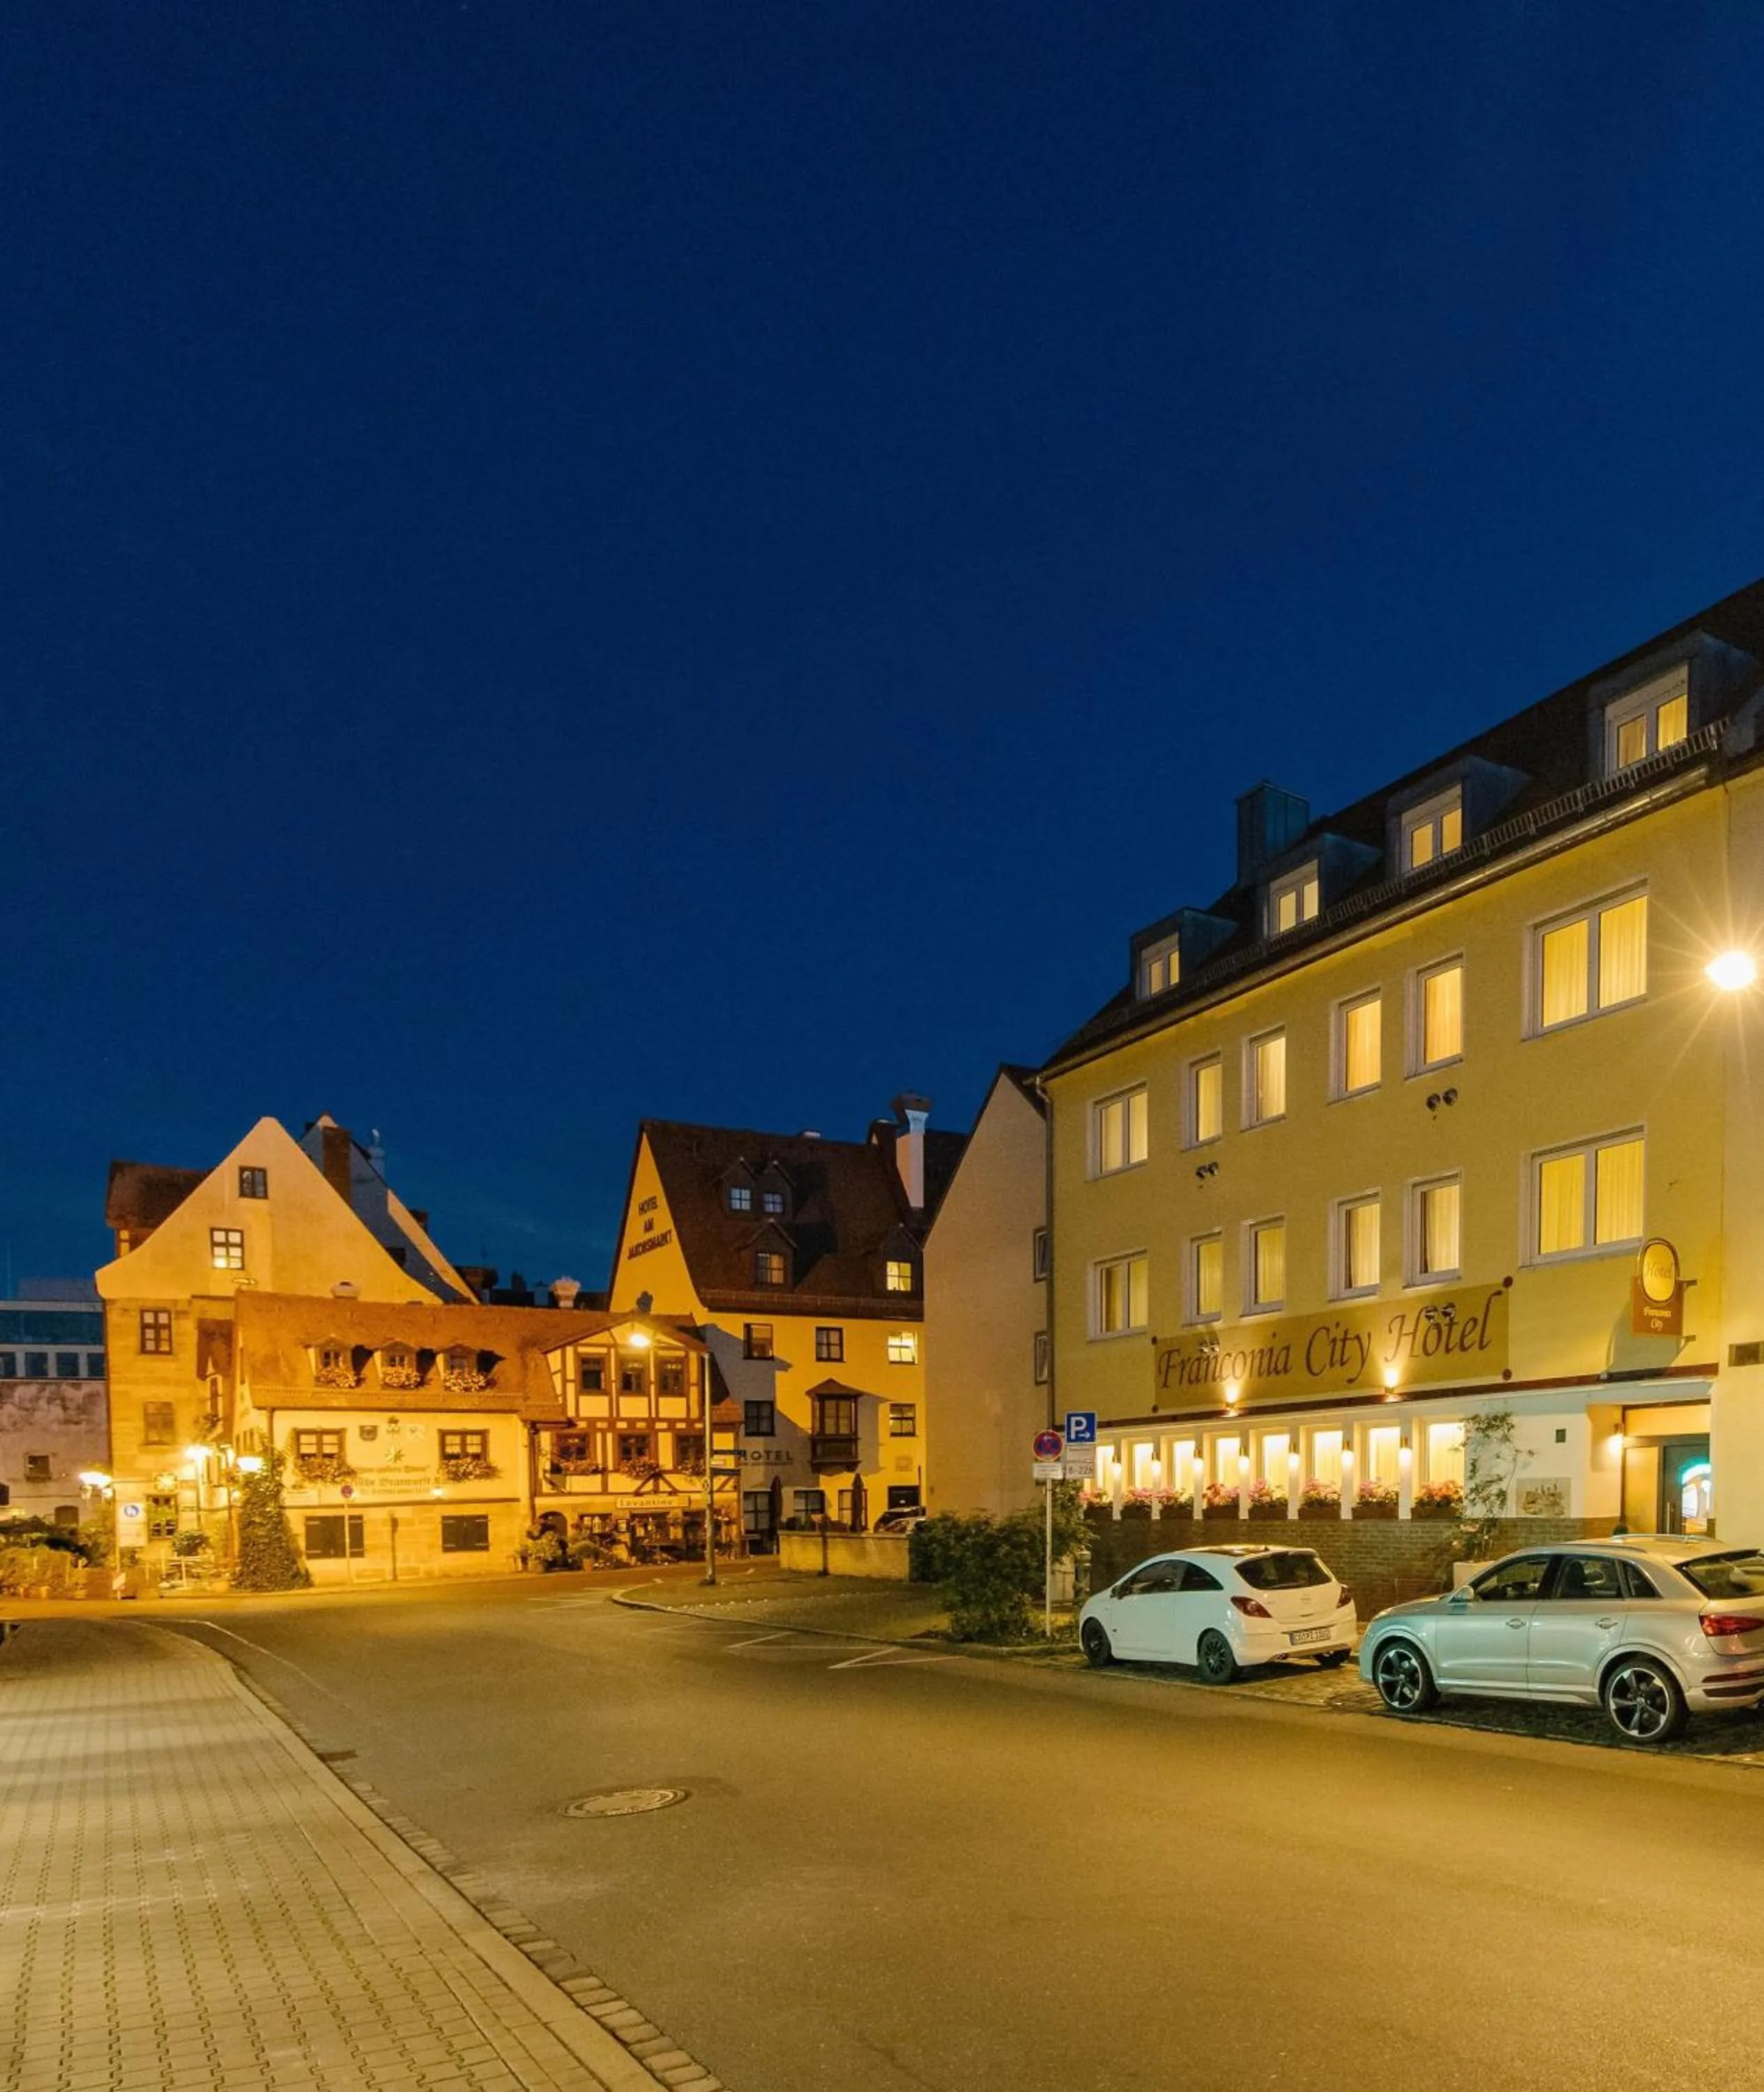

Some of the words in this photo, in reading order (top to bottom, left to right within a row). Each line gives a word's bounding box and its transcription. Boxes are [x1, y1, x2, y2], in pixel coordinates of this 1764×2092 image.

[1158, 1331, 1293, 1389] Franconia
[1305, 1321, 1371, 1384] City
[1384, 1290, 1503, 1363] Hotel
[1070, 1416, 1088, 1440] P
